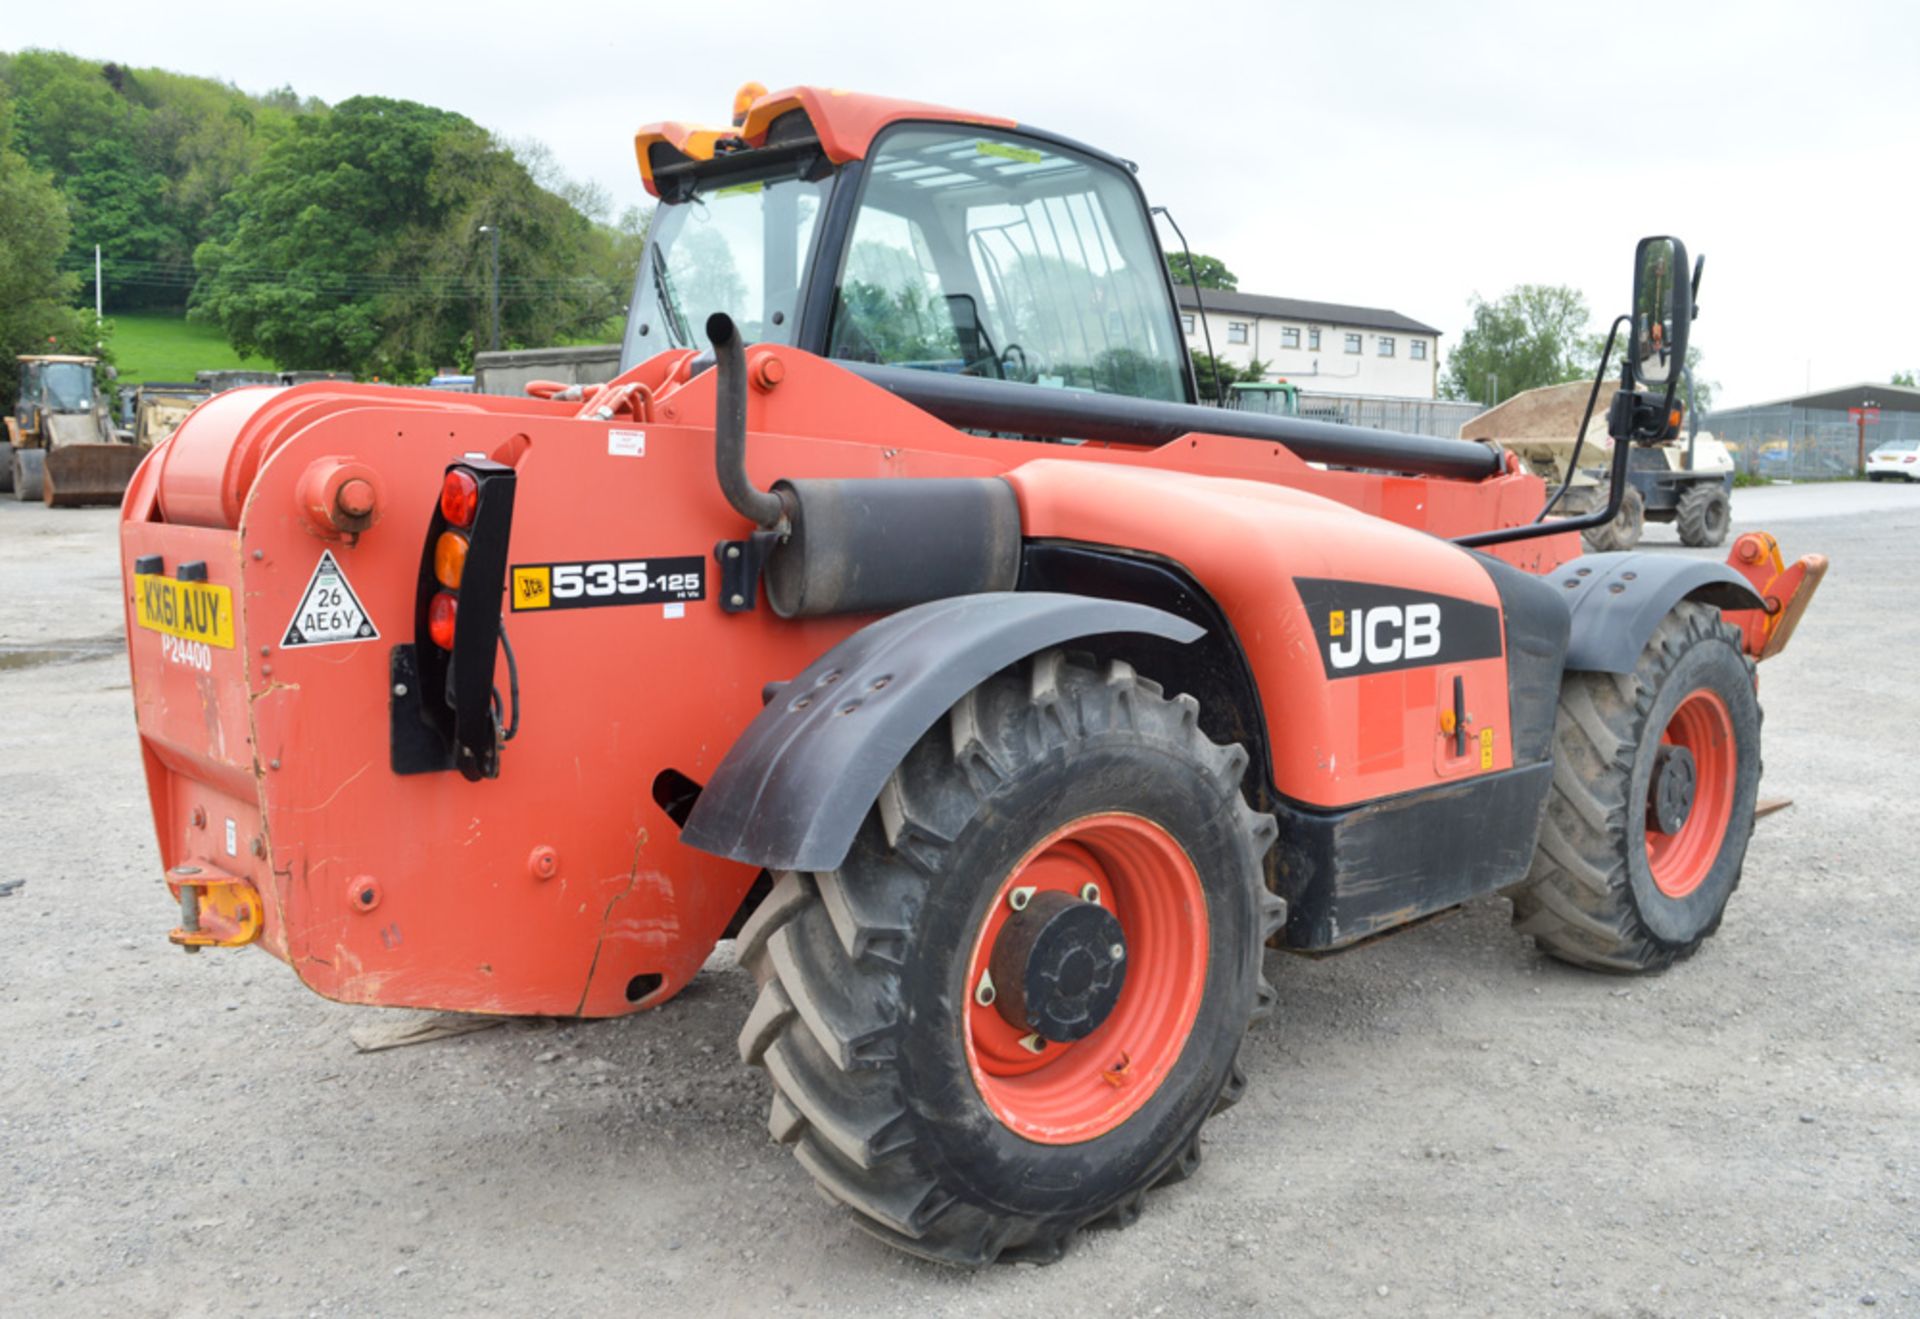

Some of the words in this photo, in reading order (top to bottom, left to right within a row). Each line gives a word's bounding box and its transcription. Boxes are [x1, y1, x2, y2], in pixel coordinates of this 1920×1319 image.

[143, 578, 179, 628] KX61
[183, 587, 220, 637] AUY
[318, 588, 342, 608] 26
[304, 609, 355, 632] AE6Y
[1329, 602, 1442, 669] JCB
[161, 632, 213, 673] P24400
